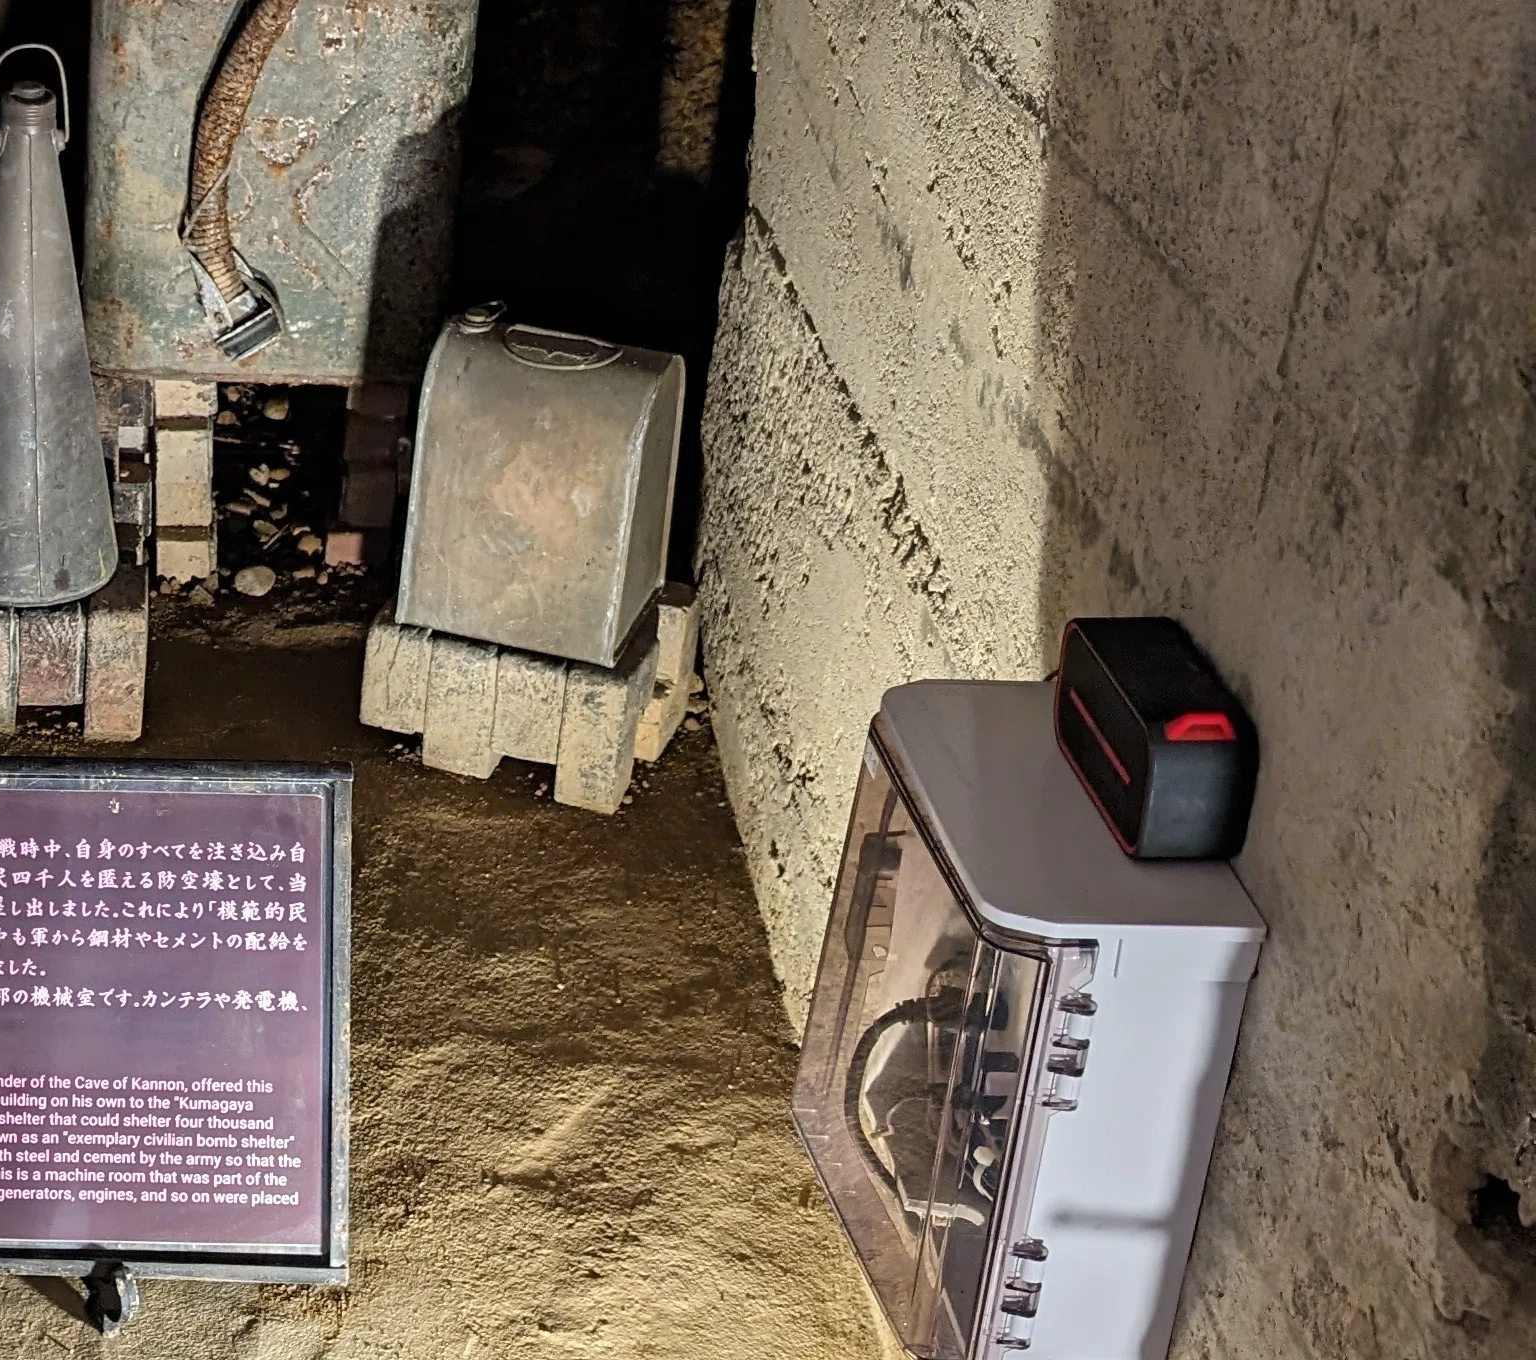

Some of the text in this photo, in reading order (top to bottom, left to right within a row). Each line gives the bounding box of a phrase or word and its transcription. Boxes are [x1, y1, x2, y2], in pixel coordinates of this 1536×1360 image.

[30, 1075, 45, 1088] of
[49, 1076, 71, 1088] the
[75, 1076, 109, 1089] Cave
[113, 1077, 128, 1089] of
[132, 1078, 188, 1092] Kannon,
[192, 1078, 242, 1092] offered
[247, 1080, 273, 1093] this
[51, 1097, 68, 1107] on
[72, 1094, 92, 1107] his
[97, 1098, 125, 1108] own
[148, 1096, 170, 1109] the
[49, 1112, 76, 1125] that
[81, 1113, 119, 1126] could
[123, 1114, 171, 1127] shelter
[175, 1114, 204, 1128] four
[207, 1116, 273, 1129] thousand
[22, 1134, 38, 1143] as
[42, 1134, 59, 1143] an
[144, 1133, 192, 1146] civilian
[197, 1134, 237, 1147] bomb
[16, 1149, 49, 1162] steel
[54, 1150, 79, 1162] and
[84, 1152, 135, 1163] cement
[140, 1151, 156, 1167] by
[160, 1152, 182, 1164] the
[186, 1155, 221, 1169] army
[246, 1153, 274, 1167] that
[278, 1154, 301, 1168] the
[45, 1168, 105, 1181] machine
[109, 1172, 145, 1182] room
[149, 1170, 177, 1183] that
[181, 1174, 209, 1184] was
[214, 1173, 242, 1187] part
[246, 1172, 261, 1185] of
[264, 1173, 287, 1186] the
[79, 1188, 137, 1203] engines,
[141, 1189, 166, 1201] and
[192, 1193, 209, 1202] on
[213, 1193, 248, 1203] were
[252, 1191, 298, 1207] placed
